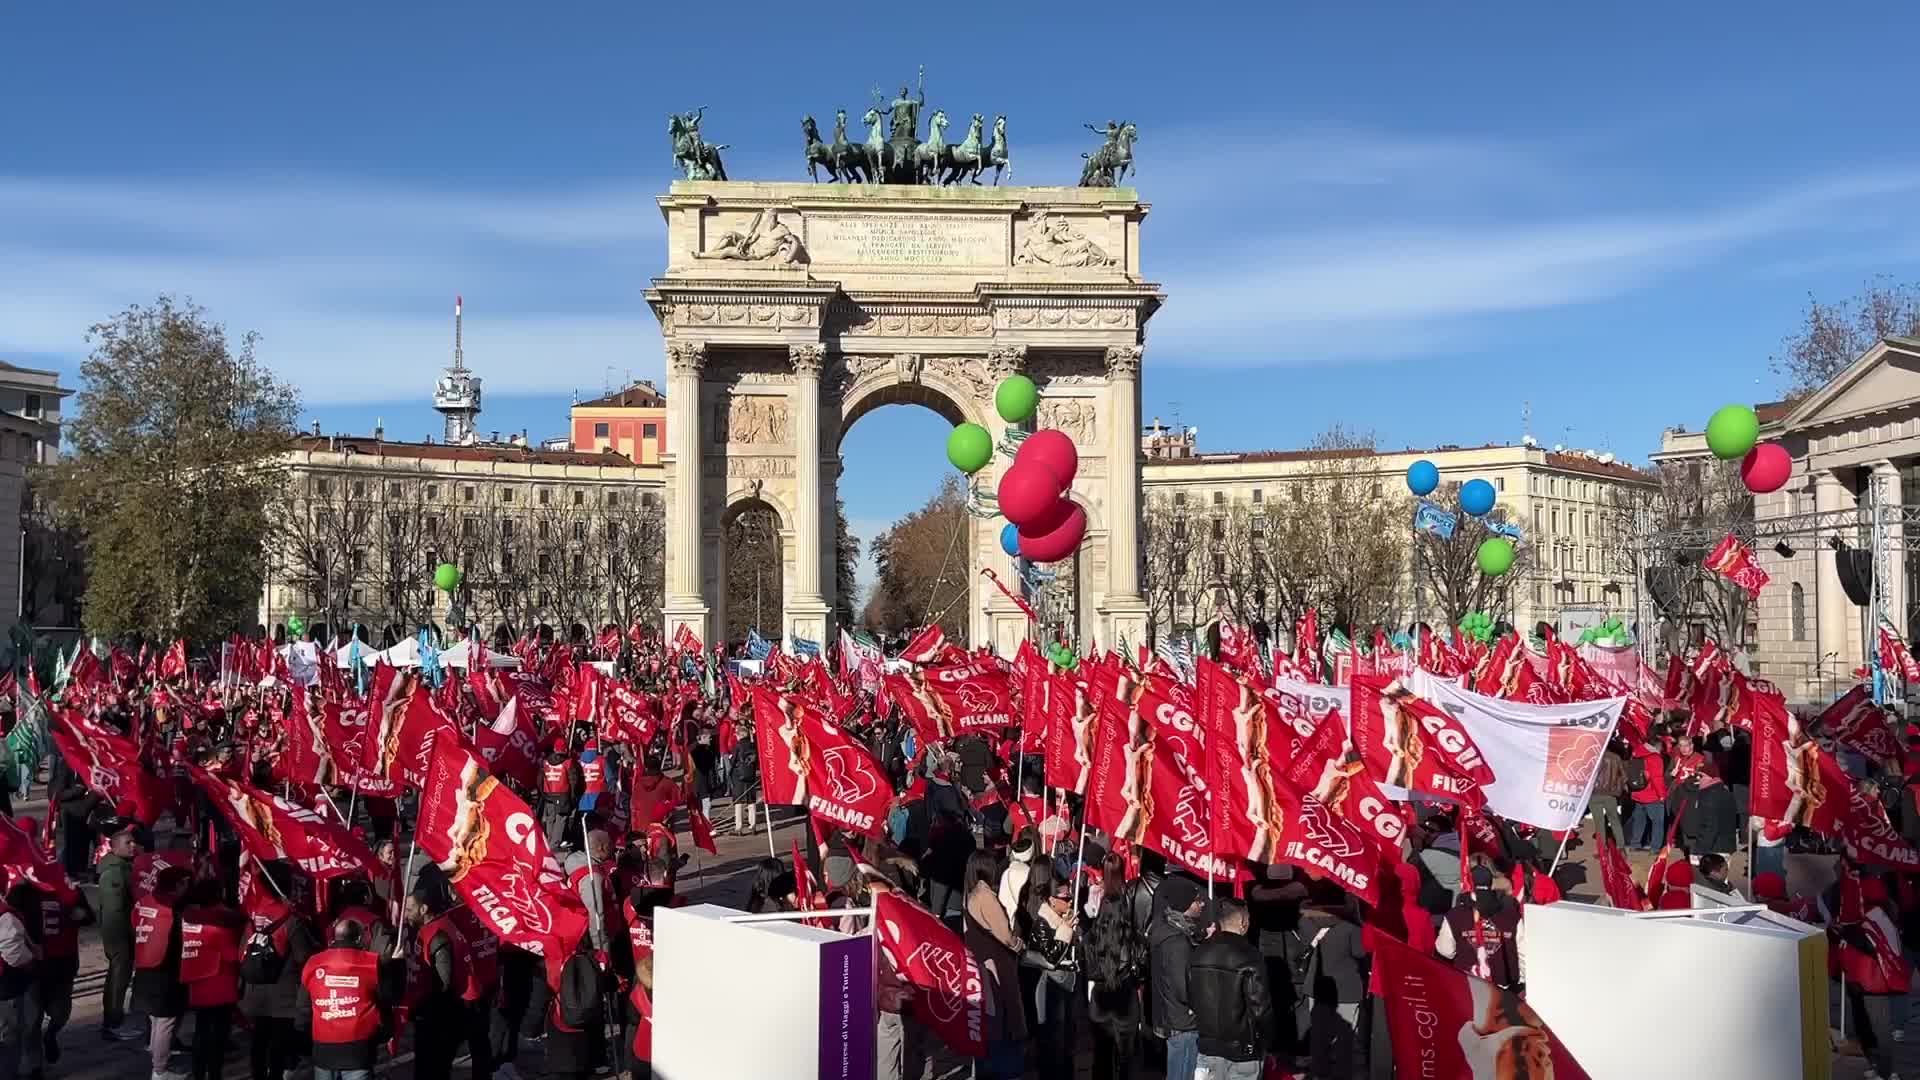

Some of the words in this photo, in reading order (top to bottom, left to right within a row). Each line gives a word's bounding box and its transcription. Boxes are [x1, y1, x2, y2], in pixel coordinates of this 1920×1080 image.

[939, 664, 988, 682] CGIL
[960, 714, 1010, 727] FILCAMS
[809, 795, 875, 830] FILCAMS
[842, 1001, 850, 1029] Viaggi
[842, 1031, 849, 1040] di
